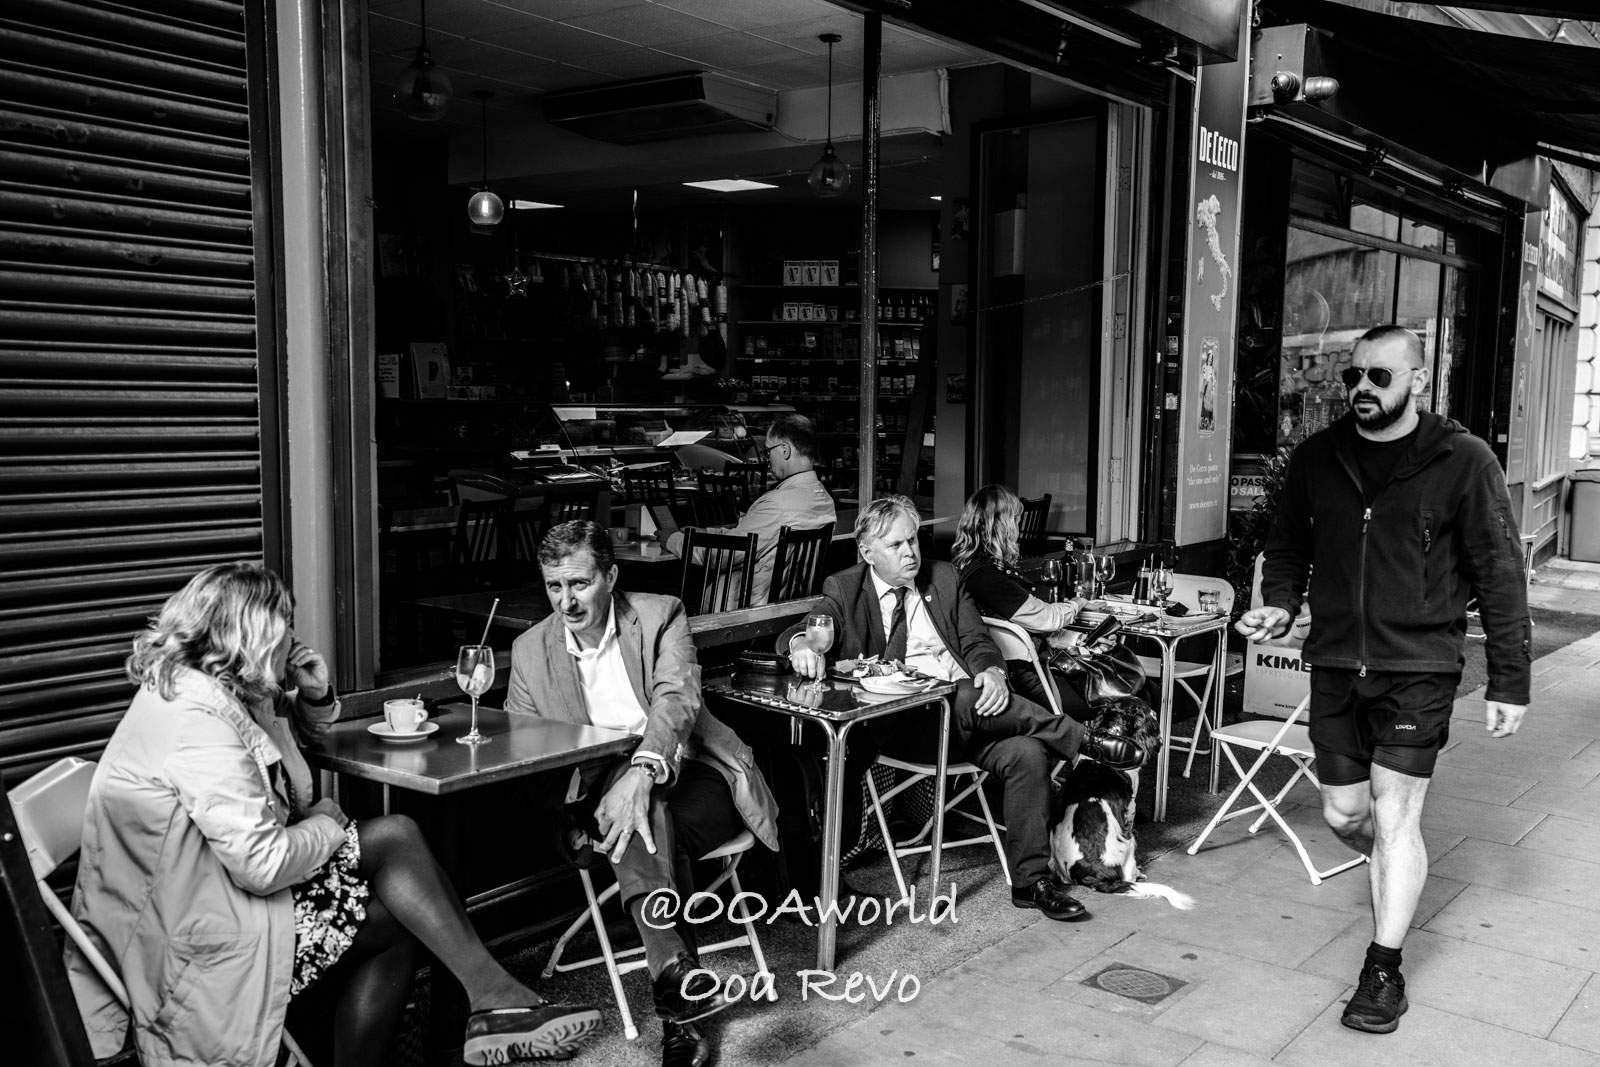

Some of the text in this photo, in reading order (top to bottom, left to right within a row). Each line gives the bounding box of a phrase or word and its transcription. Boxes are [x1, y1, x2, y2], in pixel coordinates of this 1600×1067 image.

[1231, 477, 1239, 487] O
[1231, 487, 1238, 496] O
[1256, 668, 1292, 678] ESPRESSO
